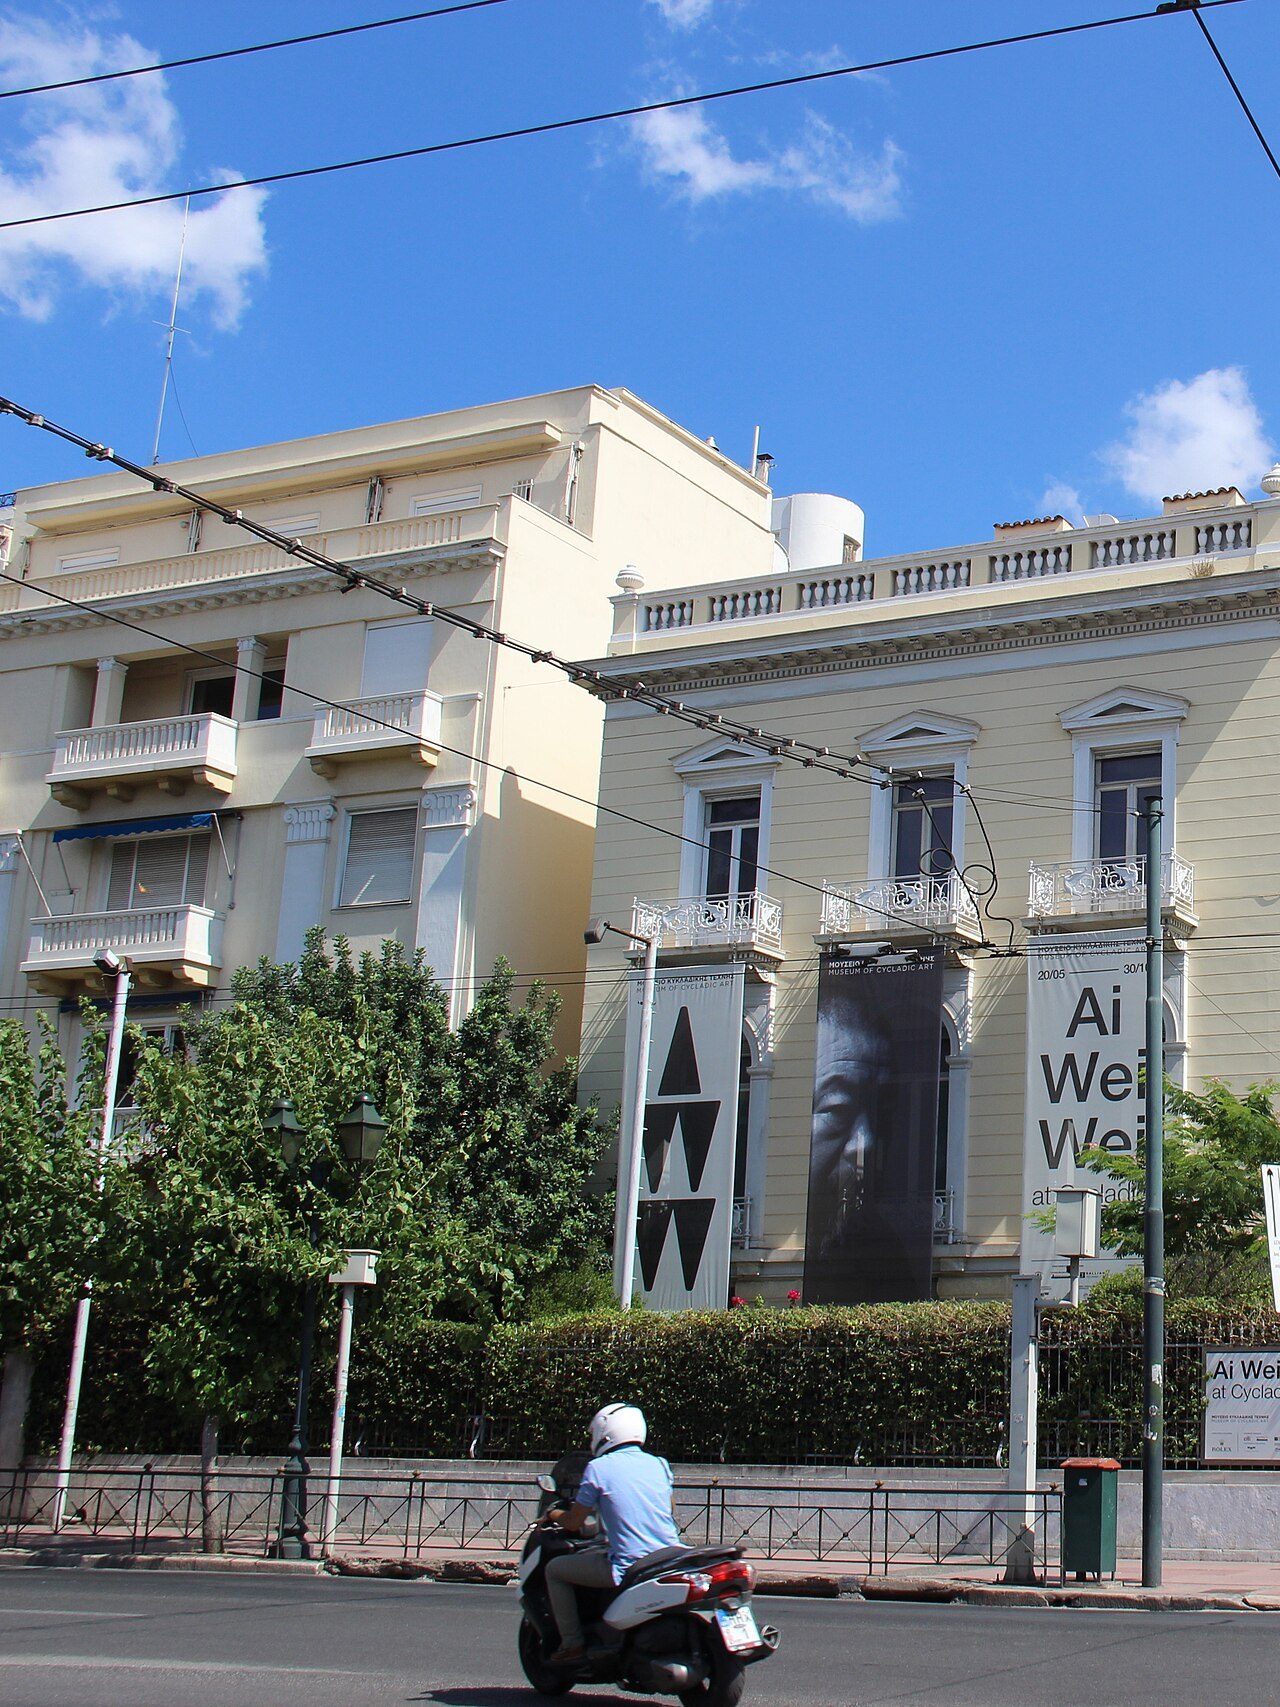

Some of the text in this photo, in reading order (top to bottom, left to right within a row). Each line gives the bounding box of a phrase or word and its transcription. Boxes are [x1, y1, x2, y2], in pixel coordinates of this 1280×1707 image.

[828, 968, 861, 976] MUSEUM
[876, 964, 916, 973] CYCLADIC
[1038, 969, 1066, 981] 20/05
[680, 981, 717, 990] CYCLADIC
[1066, 985, 1121, 1037] Ai
[1040, 1049, 1146, 1103] Wei
[1032, 1187, 1051, 1205] at
[1213, 1360, 1234, 1379] Ai
[1212, 1385, 1226, 1399] at
